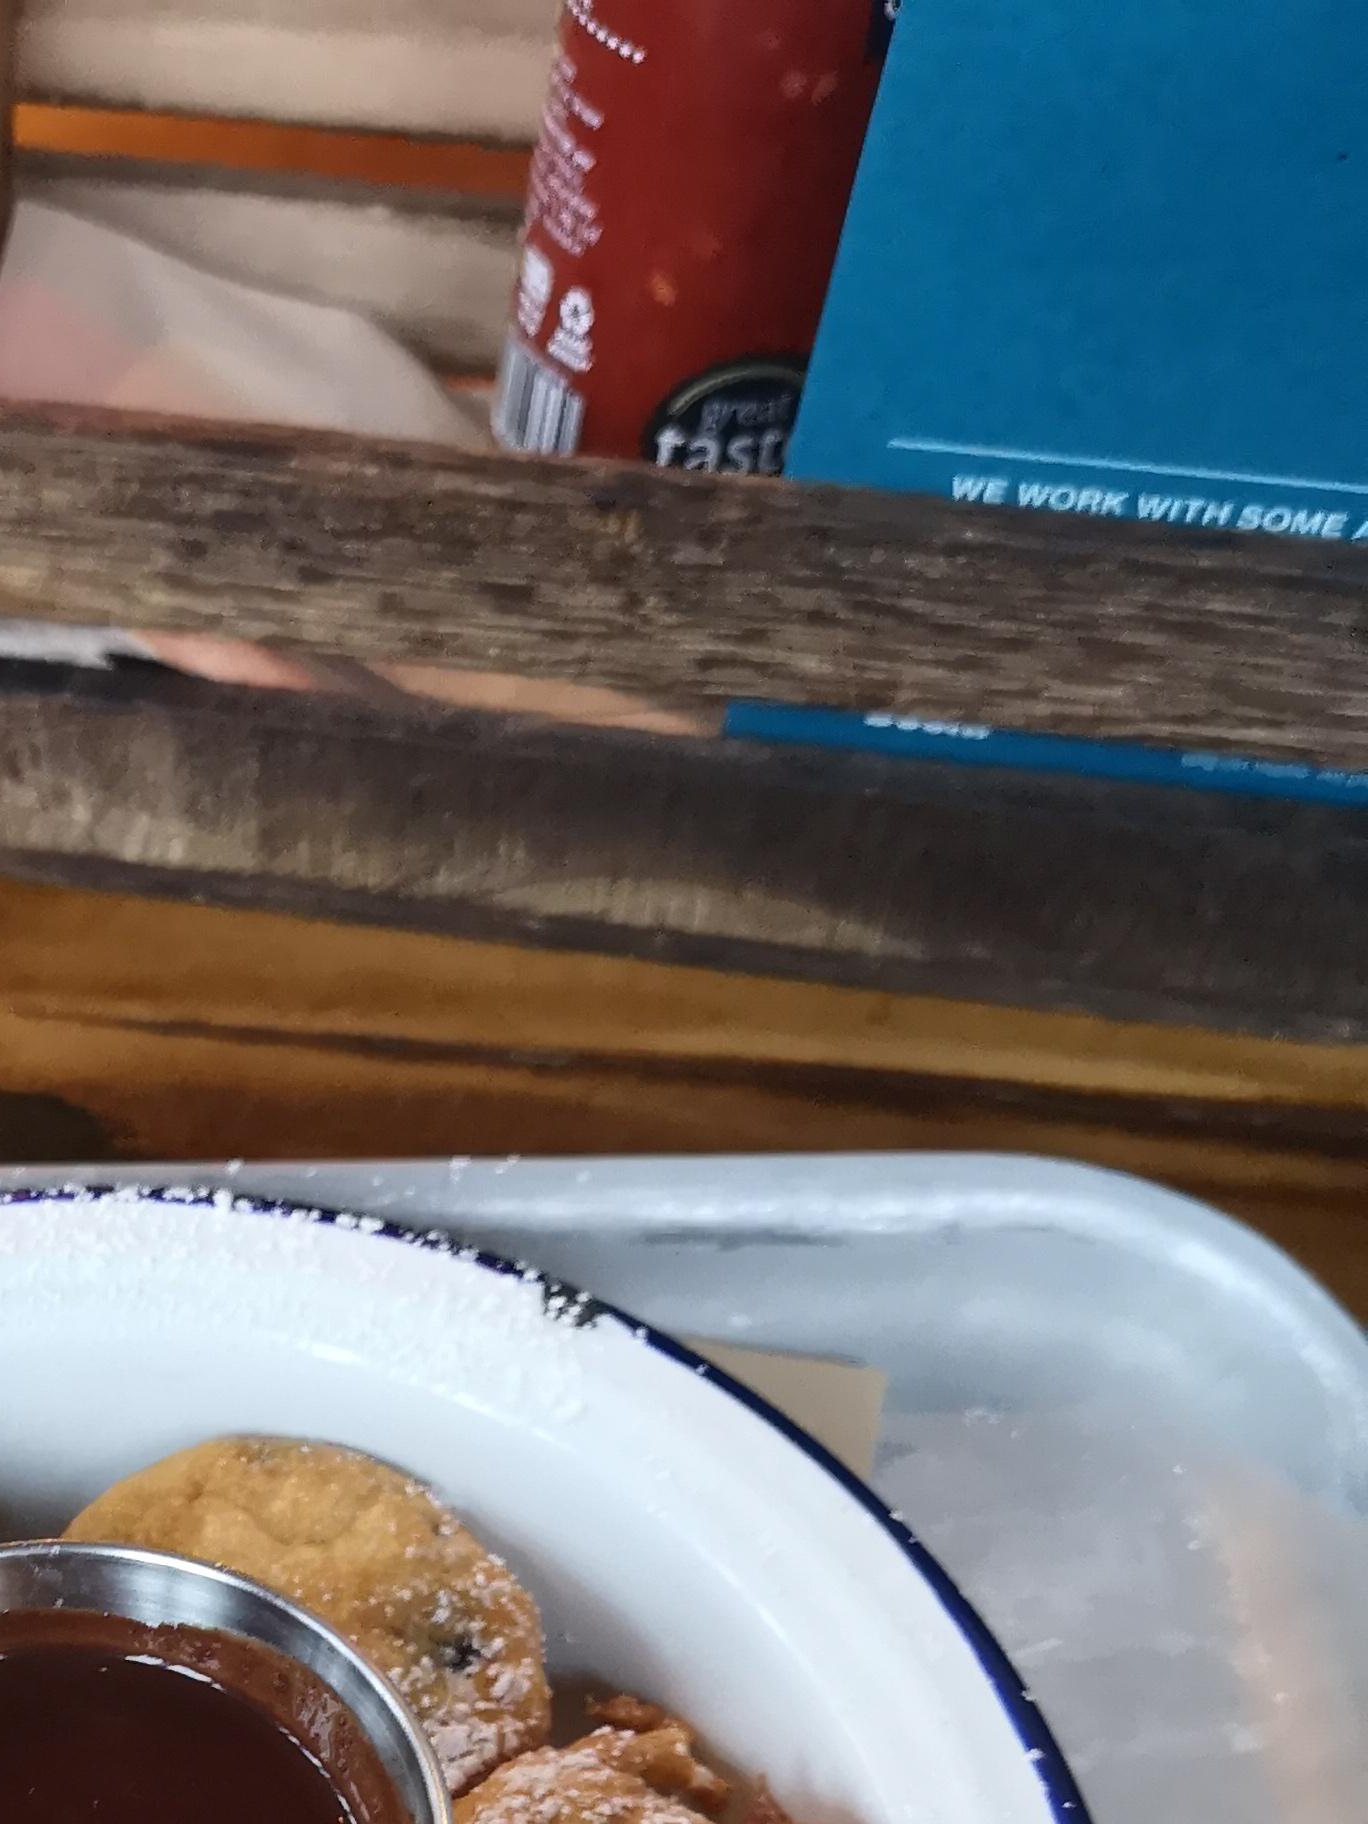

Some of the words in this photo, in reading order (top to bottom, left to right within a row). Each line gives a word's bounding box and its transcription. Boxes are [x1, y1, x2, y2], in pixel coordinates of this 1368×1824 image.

[952, 474, 1009, 504] WE
[1018, 482, 1129, 516] WORK
[1137, 493, 1234, 527] WITH
[1236, 503, 1348, 539] SOME
